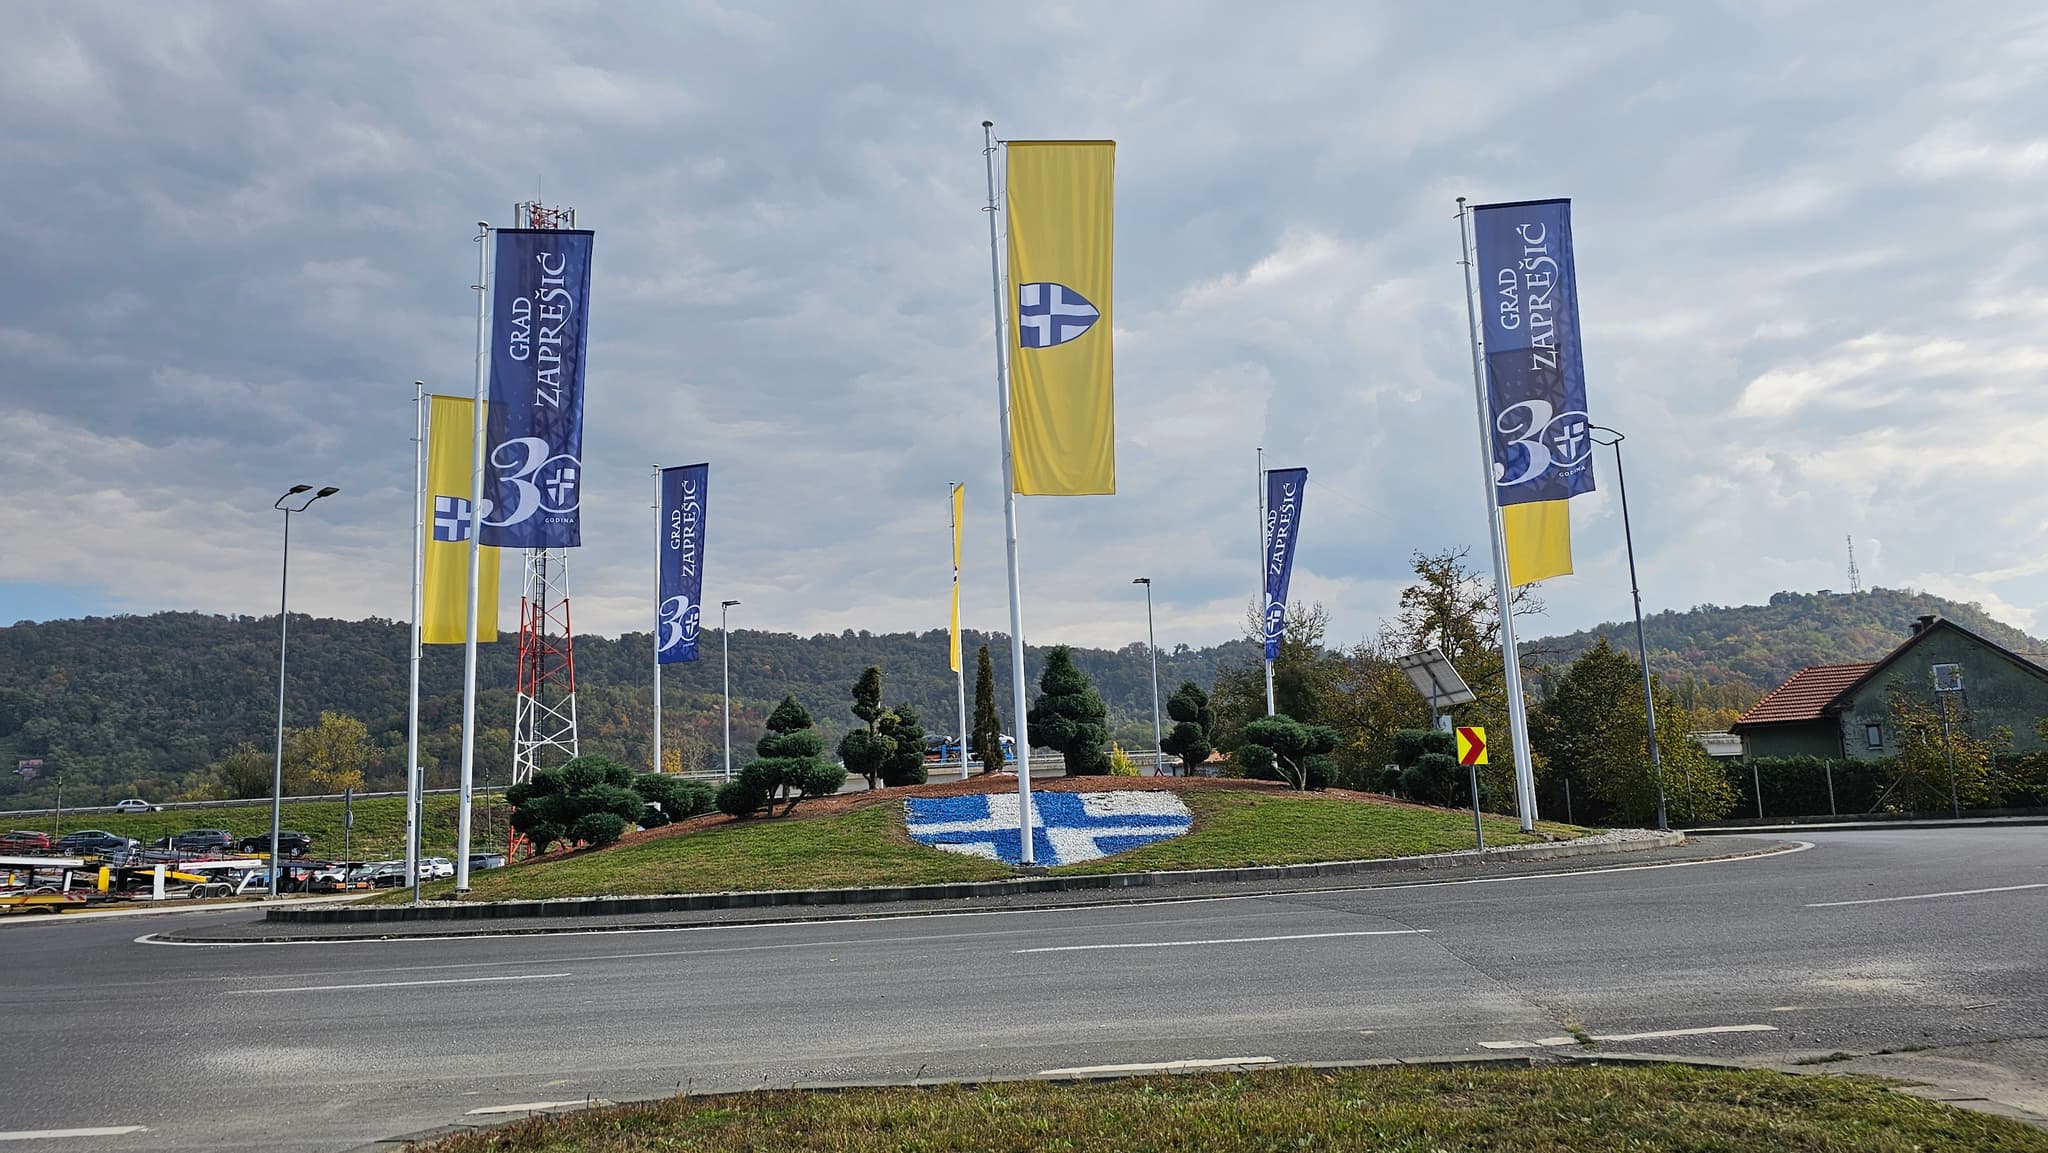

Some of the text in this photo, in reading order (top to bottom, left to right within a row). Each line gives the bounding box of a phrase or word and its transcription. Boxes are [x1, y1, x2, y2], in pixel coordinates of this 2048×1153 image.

[510, 296, 532, 361] GRAD
[533, 251, 573, 409] ZAPREŠIĆ
[1499, 268, 1520, 330] GRAD
[1516, 222, 1559, 371] ZAPREŠIĆ
[480, 436, 582, 527] 30
[1494, 399, 1592, 486] 30
[670, 509, 681, 550] GRAD
[681, 479, 701, 577] ZAPREŠIĆ
[1269, 482, 1297, 575] ZAPREŠIĆ
